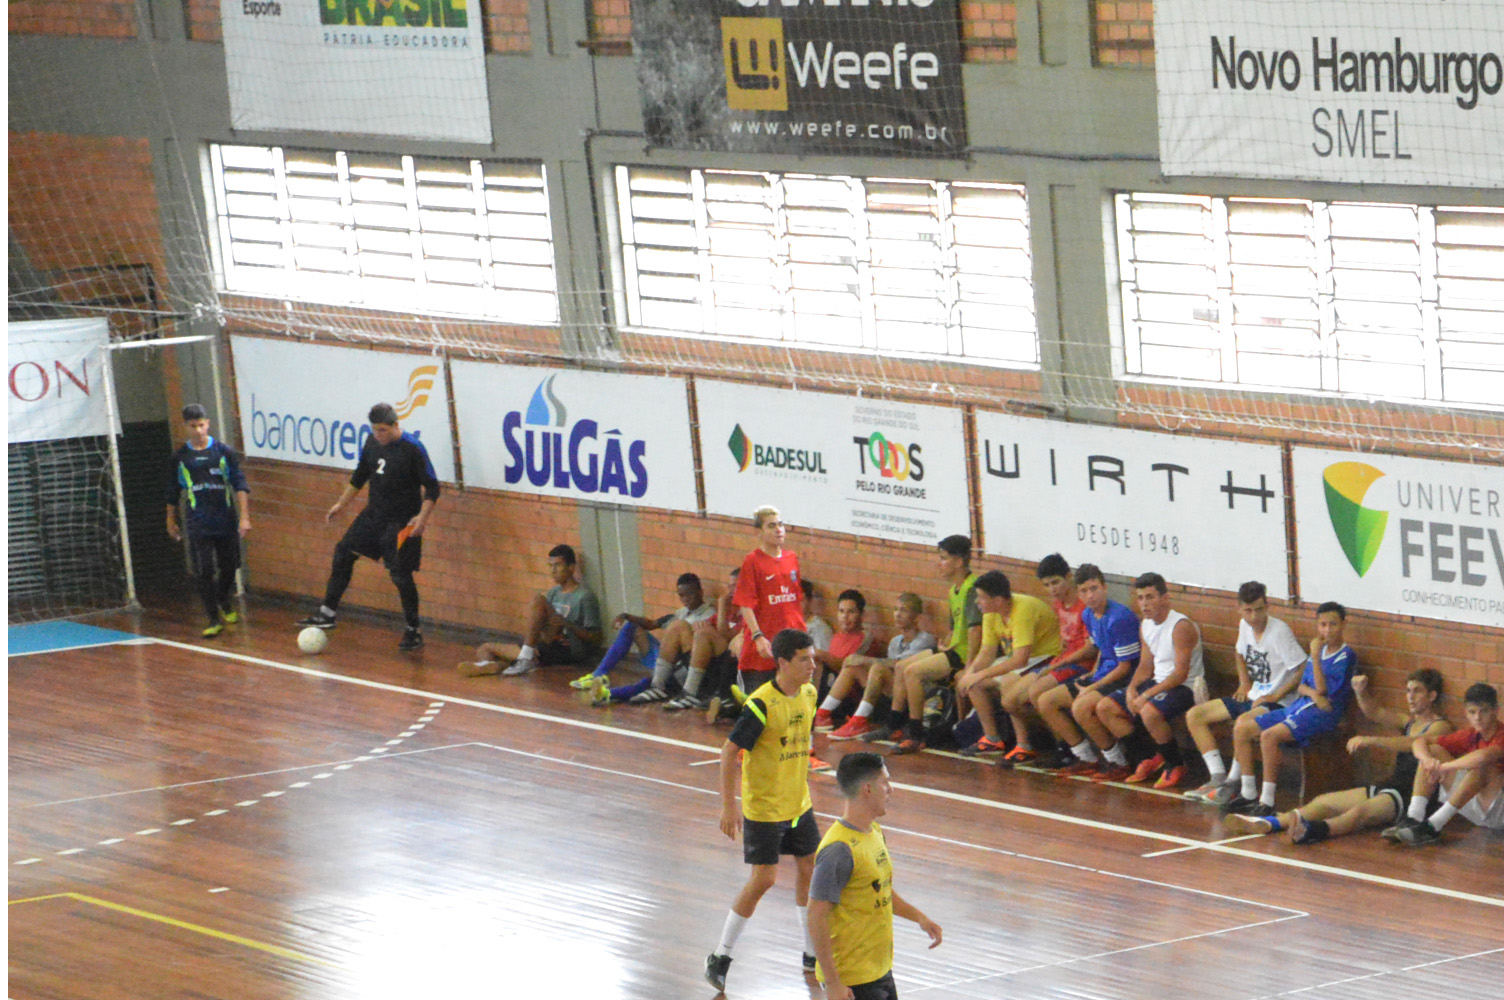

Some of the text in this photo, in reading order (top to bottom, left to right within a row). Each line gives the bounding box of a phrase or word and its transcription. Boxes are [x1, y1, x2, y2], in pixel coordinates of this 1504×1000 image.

[383, 34, 469, 47] EDUCADORA
[787, 41, 939, 90] Weefe
[1210, 36, 1503, 110] Novo Hamburgo
[731, 119, 947, 140] www.weefe.com.br
[1312, 107, 1412, 160] SMEL
[376, 458, 386, 474] 2
[754, 444, 827, 474] BADESUL
[853, 431, 924, 482] TODOS
[856, 480, 927, 499] PELO RIO GRANDE
[985, 439, 1275, 513] WIRTH
[1077, 522, 1180, 555] DESDE 1948
[1402, 588, 1487, 612] CONHECIMENTO
